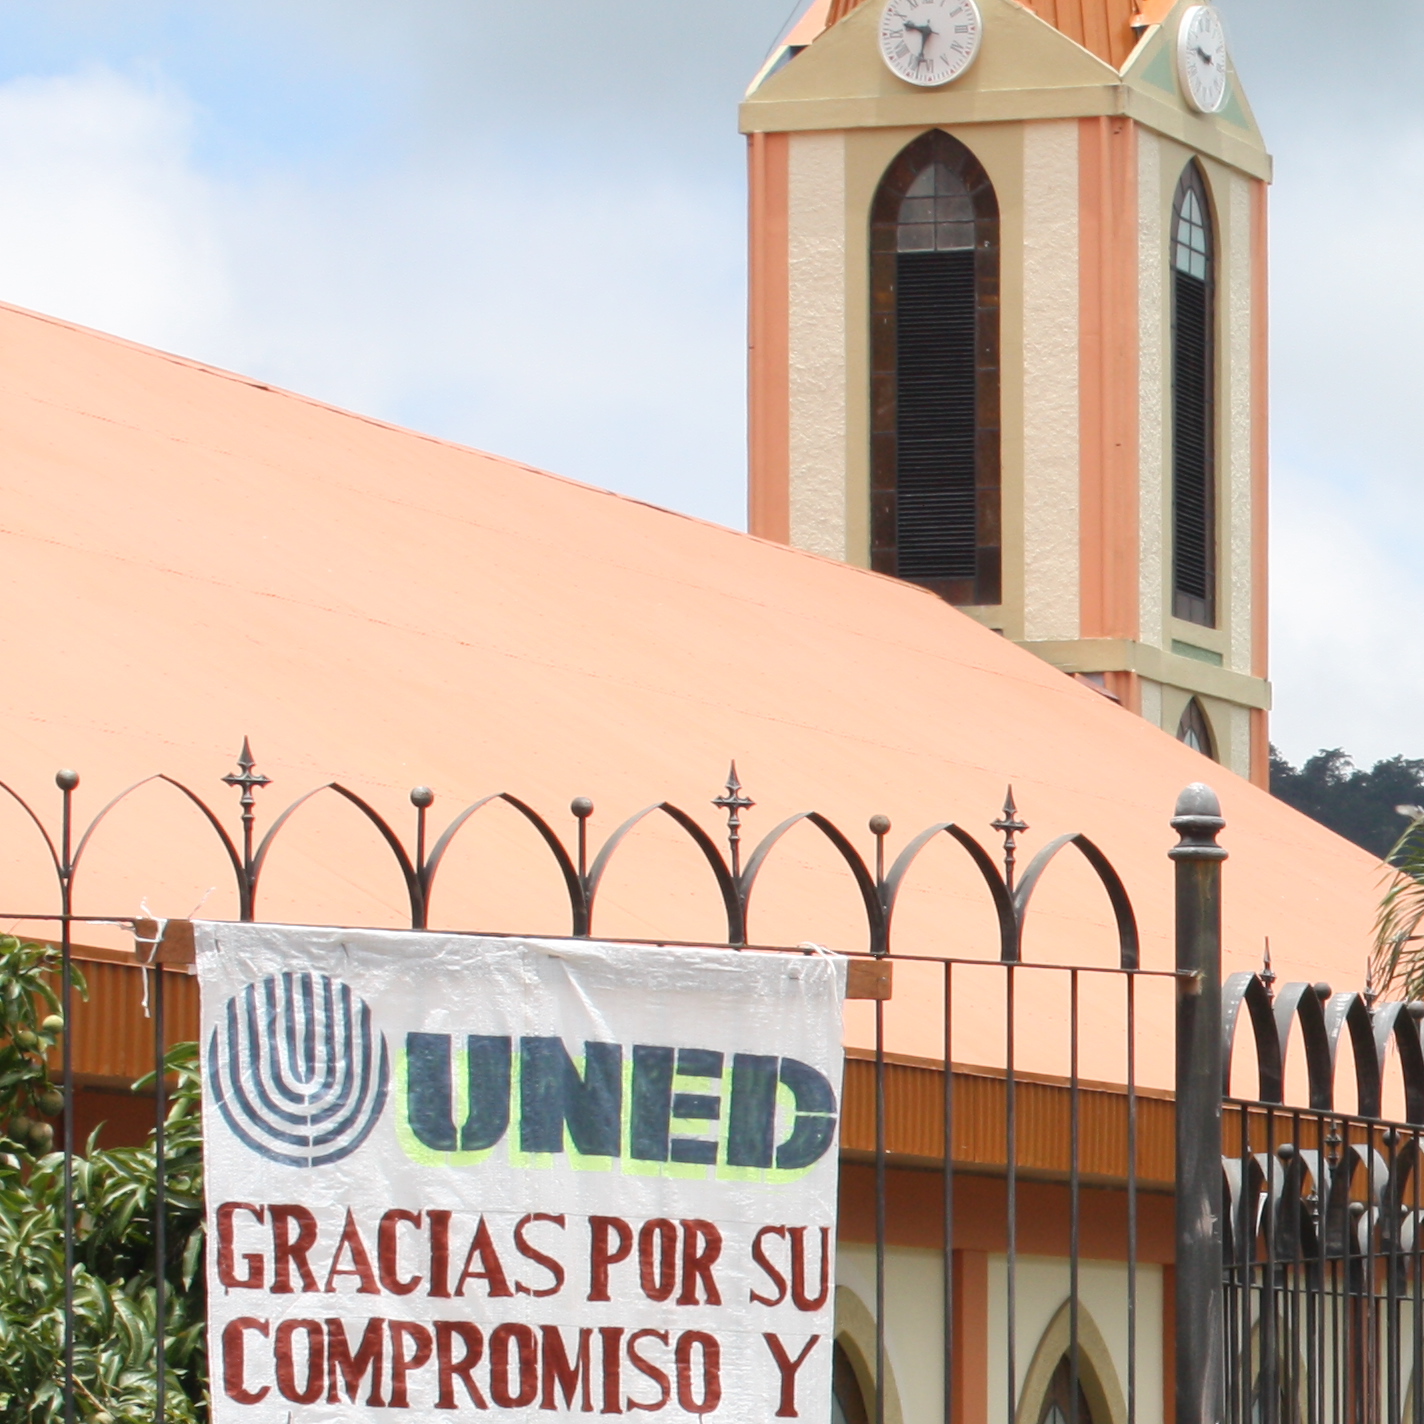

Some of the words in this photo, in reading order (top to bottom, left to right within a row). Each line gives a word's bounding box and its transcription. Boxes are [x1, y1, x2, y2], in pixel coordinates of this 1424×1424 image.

[404, 1032, 838, 1174] UNED
[215, 1200, 568, 1300] GRACIAS
[586, 1214, 724, 1308] POR
[749, 1225, 833, 1312] SU
[221, 1316, 723, 1416] COMPROMISO
[761, 1331, 822, 1419] Y
